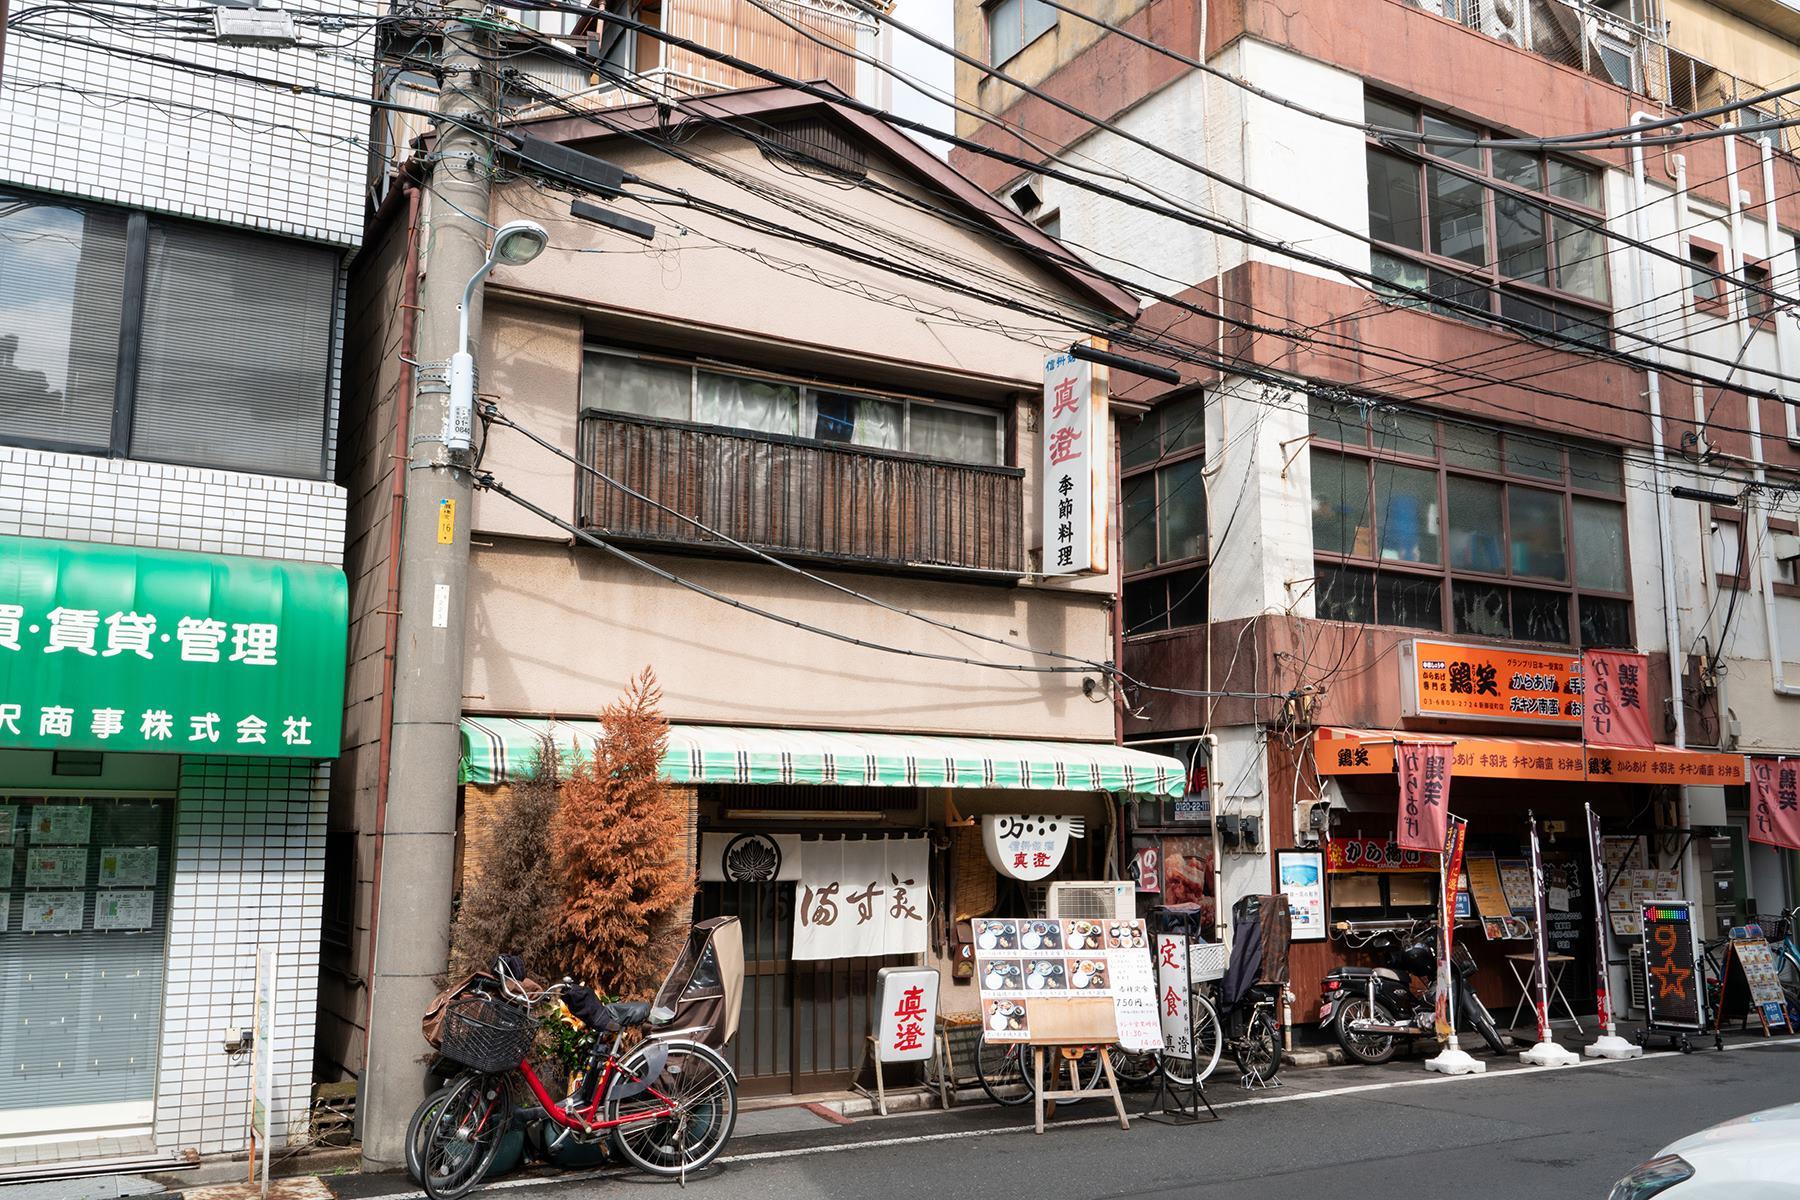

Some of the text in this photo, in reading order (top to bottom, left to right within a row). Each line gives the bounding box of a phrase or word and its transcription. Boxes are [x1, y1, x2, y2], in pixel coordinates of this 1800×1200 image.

[1049, 377, 1082, 466] 真澄
[1057, 474, 1074, 567] 季節料理
[1422, 672, 1446, 681] からあげ
[1512, 672, 1555, 692] からあげ
[1510, 696, 1559, 716] チキン南蛮
[1337, 748, 1369, 767] 鶏笑
[1479, 754, 1508, 768] 手羽先
[1512, 756, 1554, 770] チキン南蛮
[1558, 758, 1583, 770] お弁当
[1588, 757, 1613, 775] 鶏笑
[1616, 760, 1648, 774] からあげ
[1651, 762, 1675, 775] 手羽先
[1679, 762, 1715, 777] チキン南蛮
[1718, 765, 1740, 778] お弁当
[1013, 851, 1051, 868] 真澄
[1160, 938, 1182, 1017] 定食
[893, 985, 927, 1051] 真澄
[1164, 1033, 1190, 1055] 真澄
